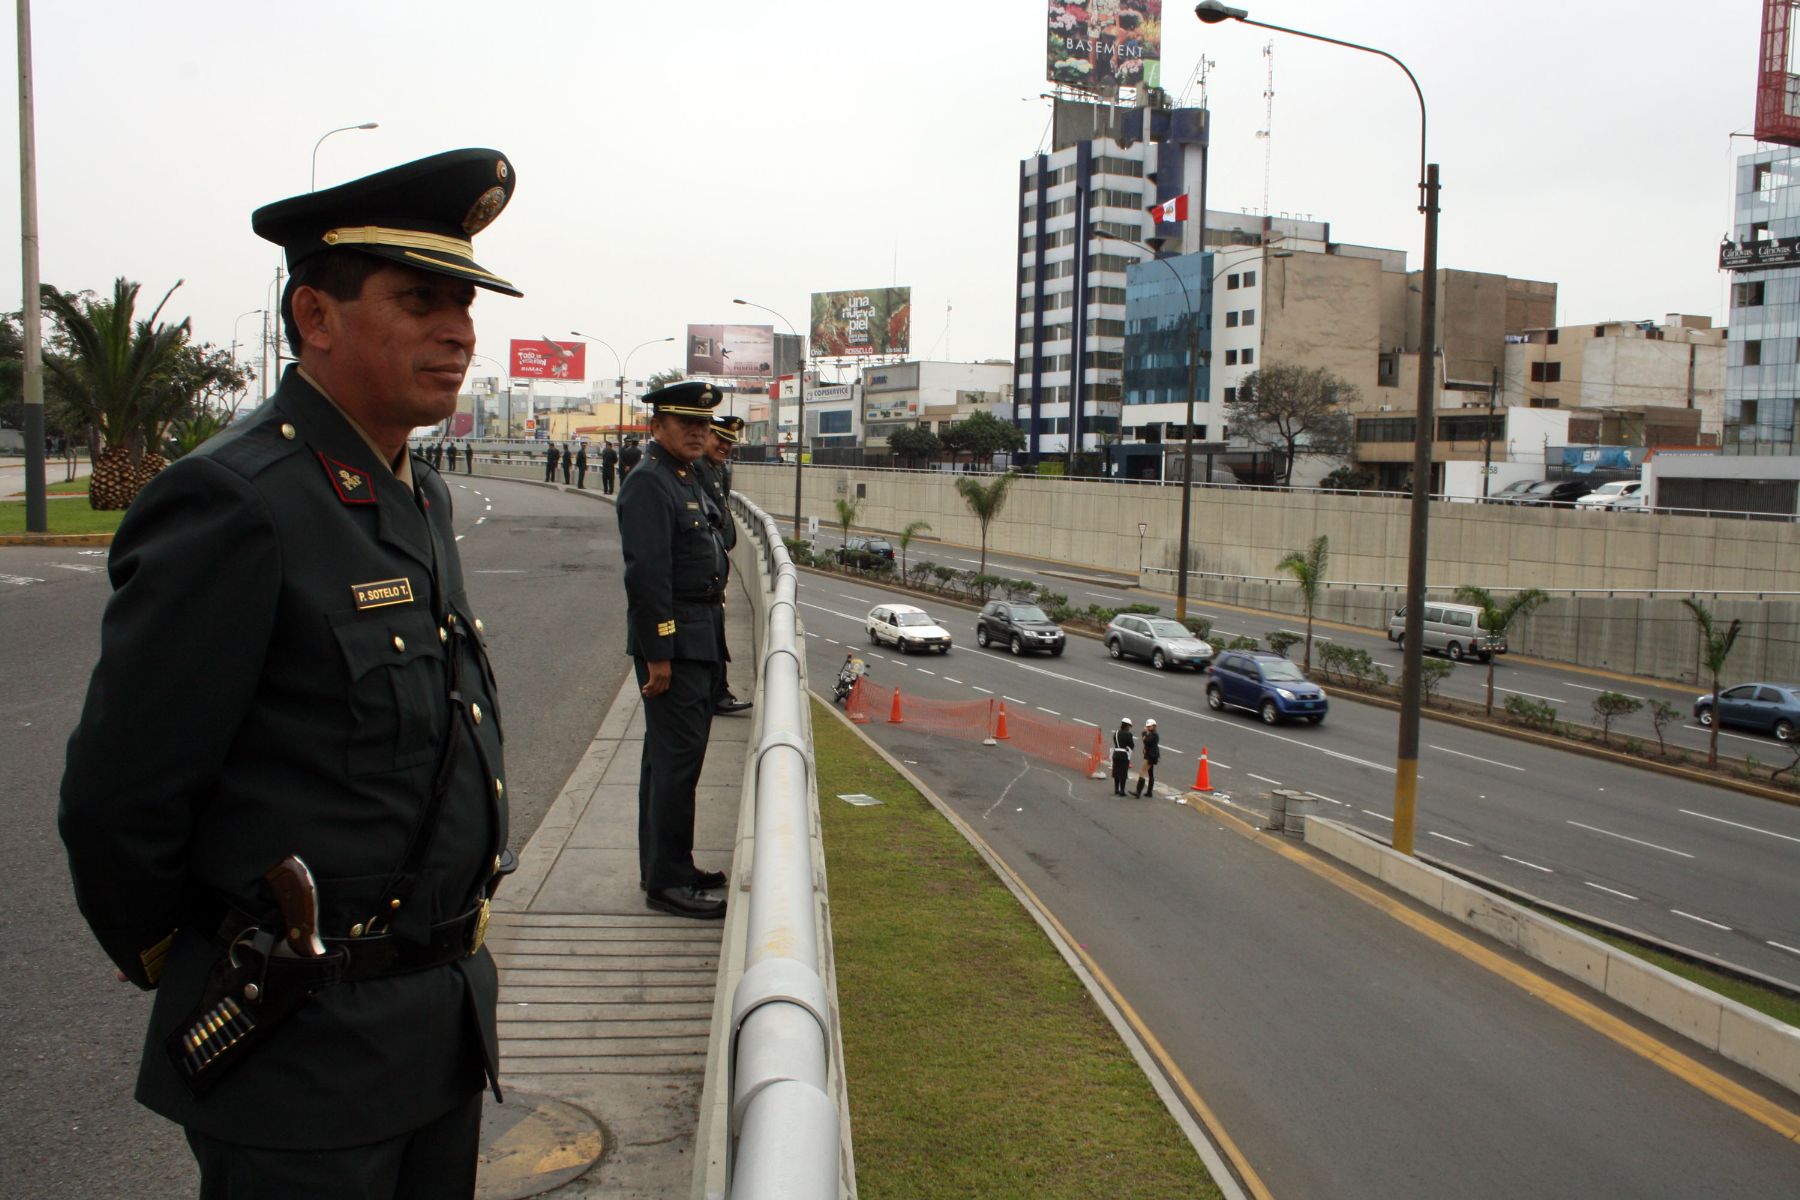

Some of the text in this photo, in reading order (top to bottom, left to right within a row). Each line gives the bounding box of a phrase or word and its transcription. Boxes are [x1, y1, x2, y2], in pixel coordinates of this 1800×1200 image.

[1066, 38, 1144, 57] BASEMENT
[848, 296, 870, 307] una
[849, 317, 869, 332] piel
[814, 387, 849, 397] COPISERVICE
[1481, 465, 1498, 475] 258
[358, 585, 409, 602] P. SOTELO T.
